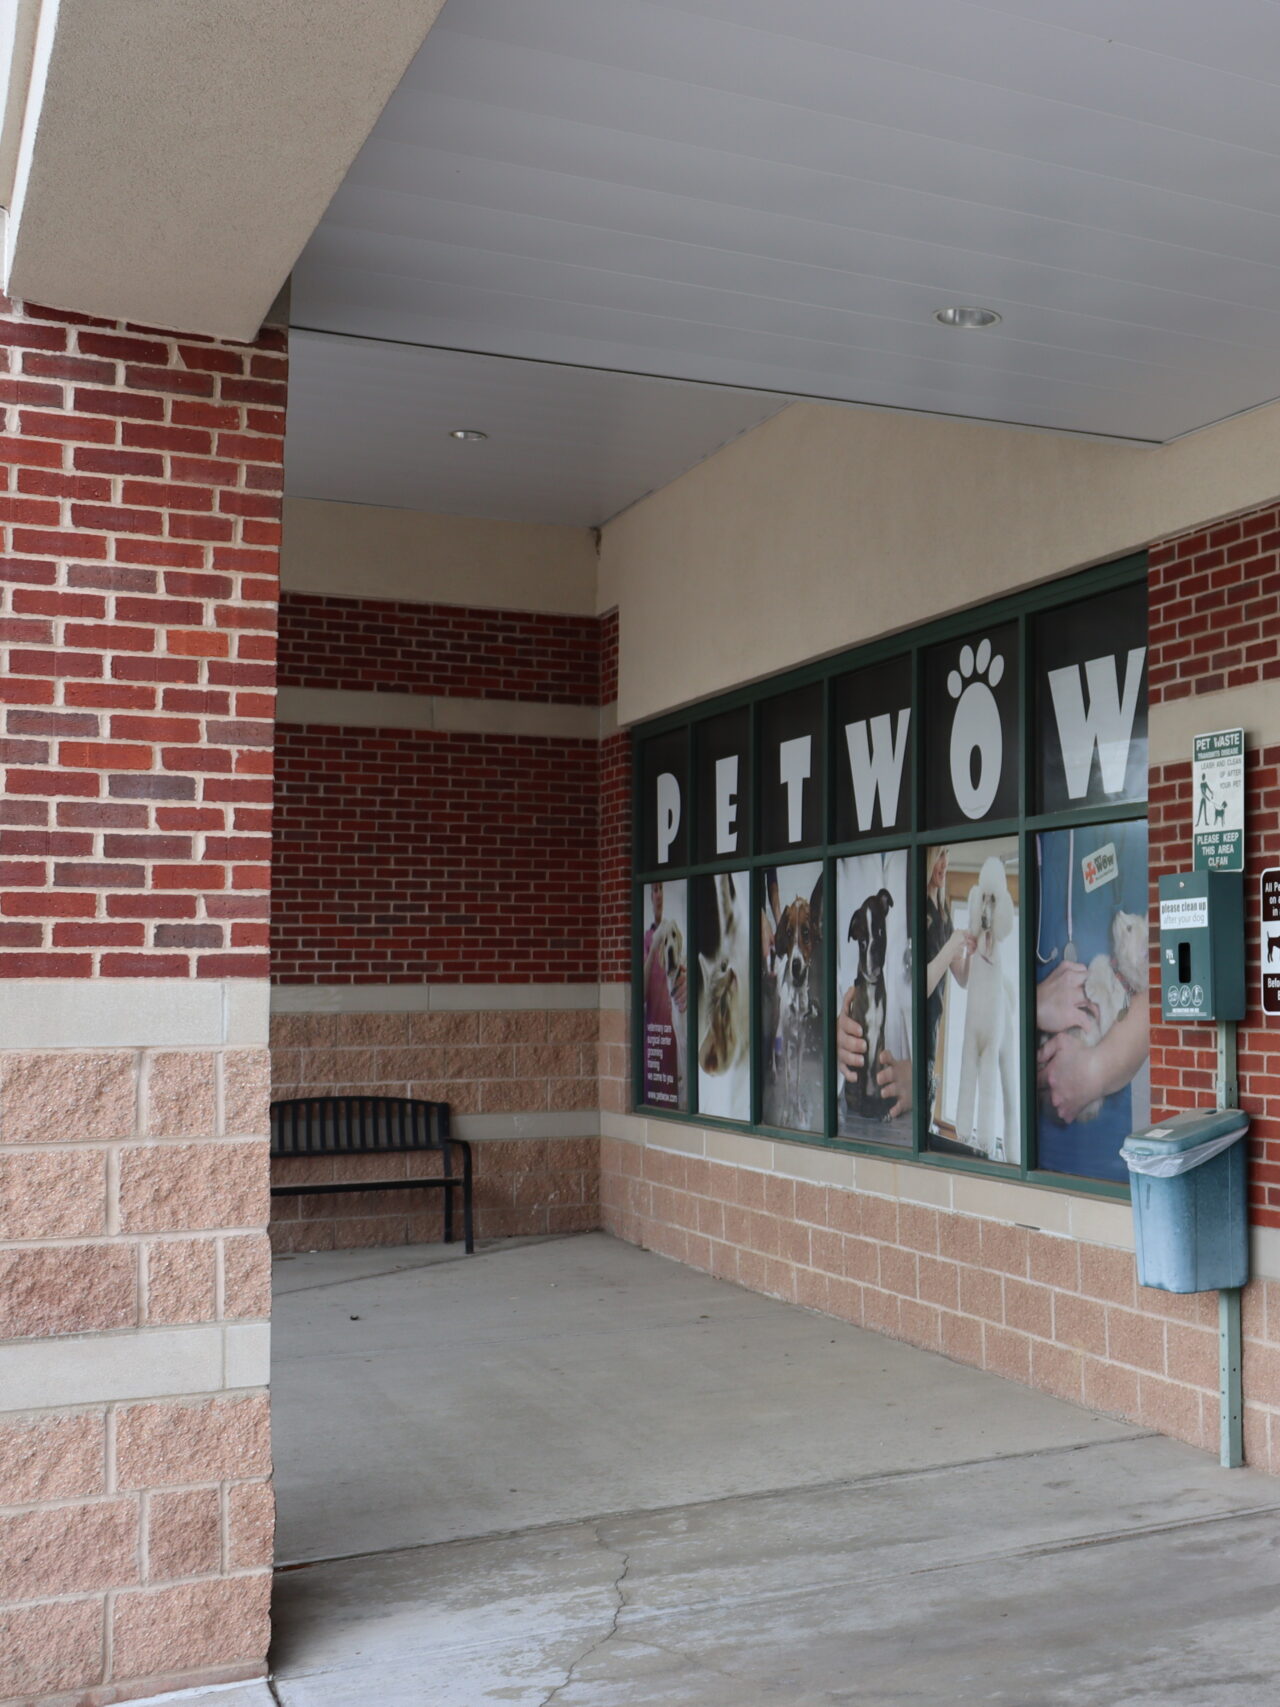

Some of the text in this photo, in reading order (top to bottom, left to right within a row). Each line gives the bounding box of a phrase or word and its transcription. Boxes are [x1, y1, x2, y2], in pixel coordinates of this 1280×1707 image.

[1196, 732, 1240, 751] PET WASTE
[1200, 758, 1242, 769] LEASH AND CLEAN
[1219, 769, 1241, 778] UP AFTER
[1219, 779, 1241, 789] YOUR PET
[1196, 832, 1239, 845] PLEASE KEEP
[1201, 843, 1235, 856] THIS AREA
[1208, 856, 1229, 867] CLEAN
[1264, 882, 1273, 892] All
[1269, 896, 1277, 904] on
[1161, 901, 1207, 914] please clean up
[1272, 906, 1279, 917] in
[1163, 913, 1205, 926] after your dog
